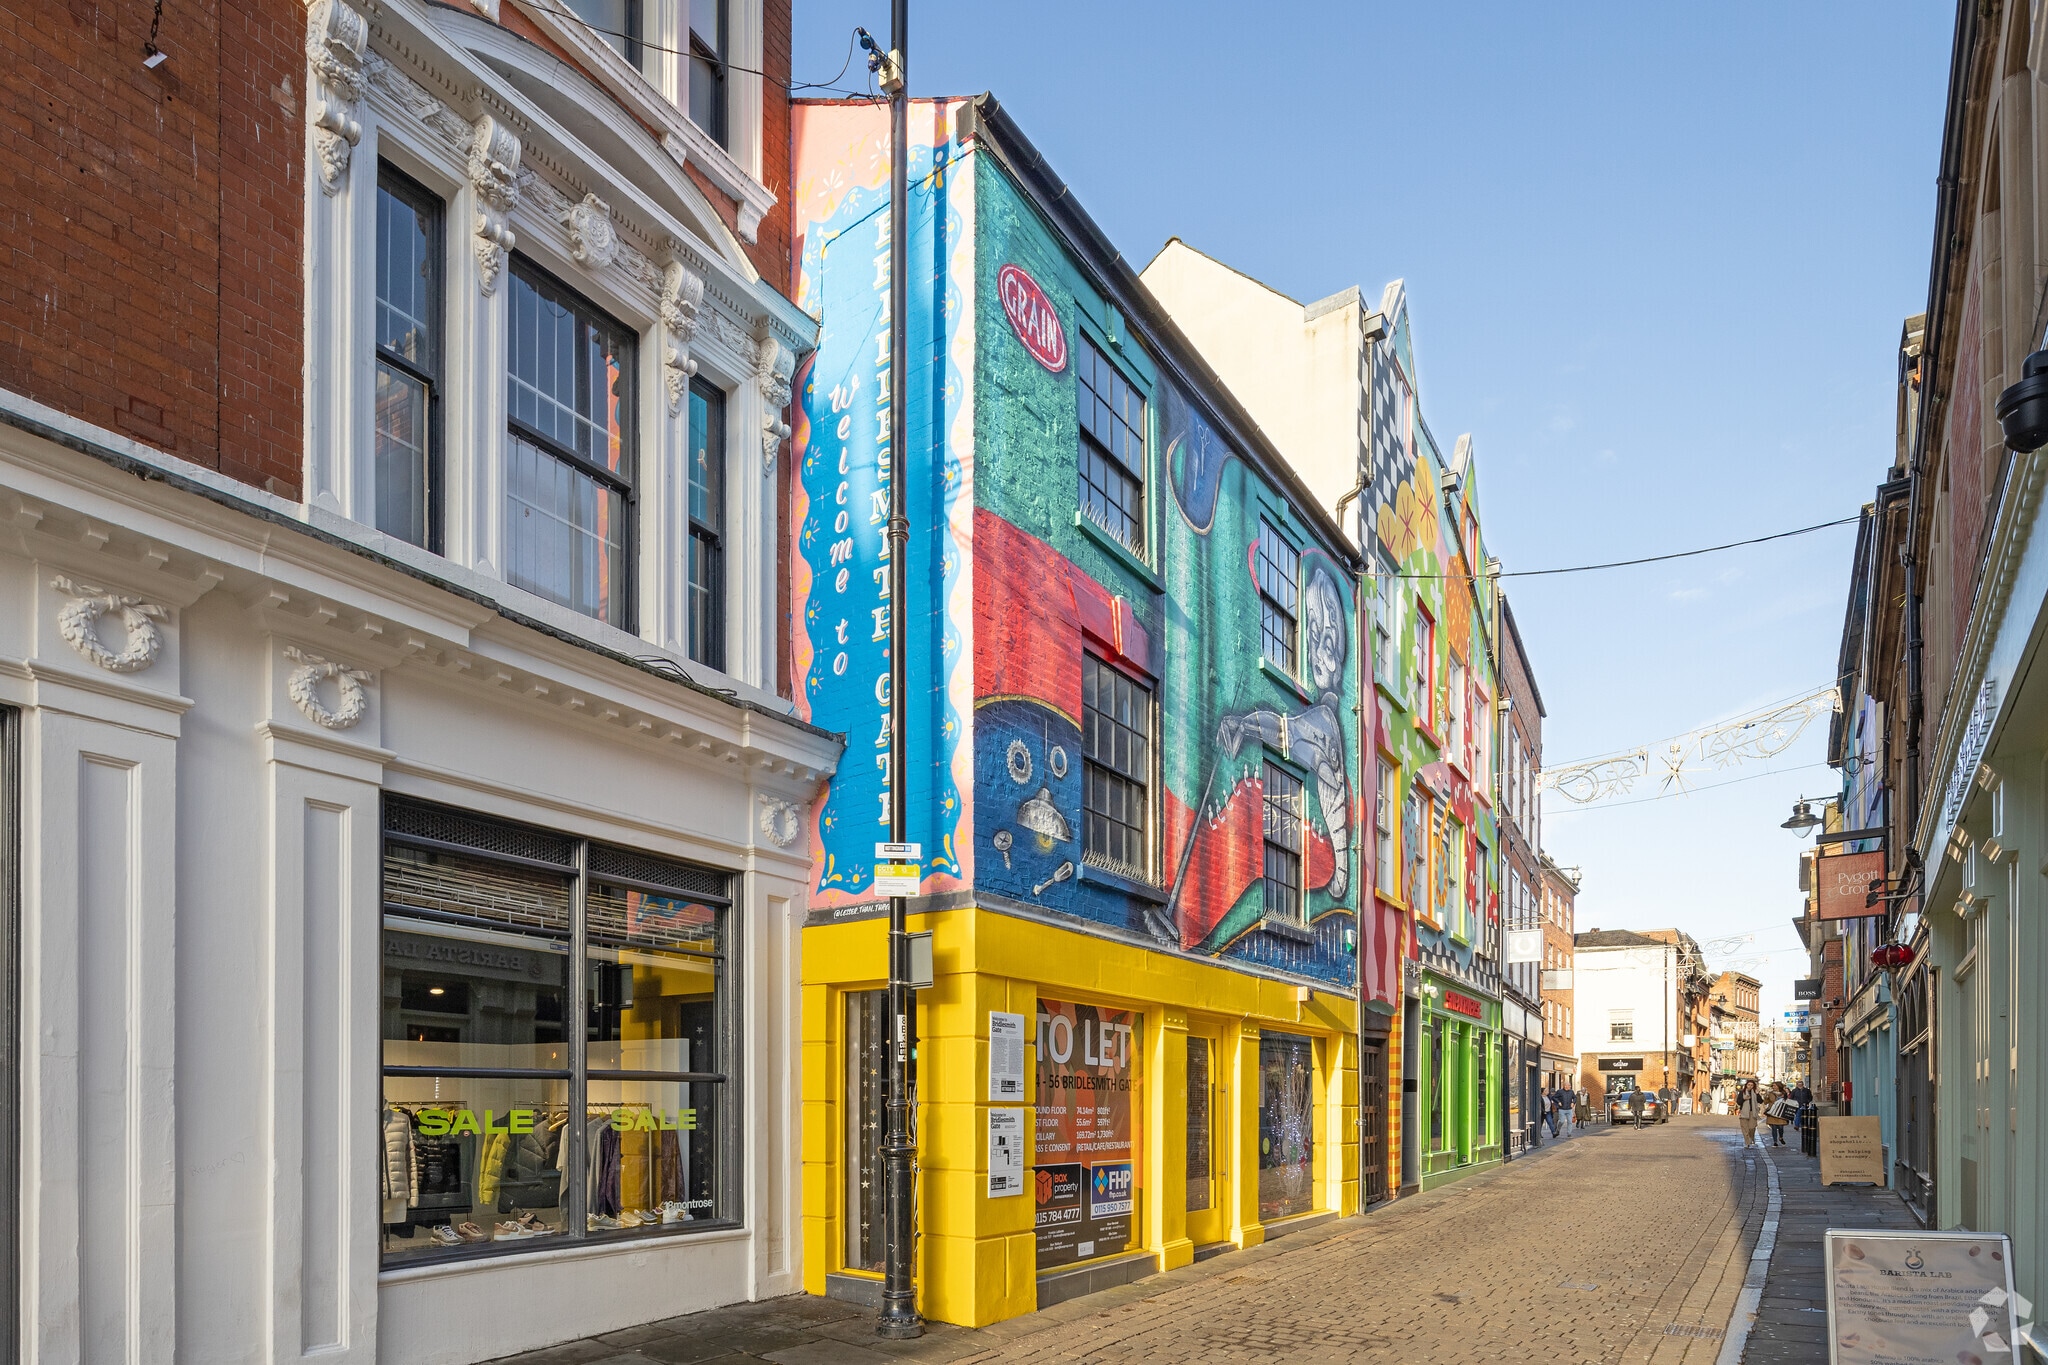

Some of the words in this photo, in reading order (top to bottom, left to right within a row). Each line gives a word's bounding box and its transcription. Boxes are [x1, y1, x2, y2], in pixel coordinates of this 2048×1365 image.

[1004, 273, 1057, 359] GRAIN
[828, 373, 860, 593] Welcome
[833, 618, 850, 676] to
[1838, 870, 1878, 884] Pygott
[1839, 885, 1870, 896] Cron
[1036, 1013, 1073, 1064] TO
[1084, 1019, 1131, 1068] LET
[1049, 1075, 1059, 1088] 56
[1062, 1075, 1116, 1091] BRIDLESMITH
[1036, 1106, 1050, 1114] OUND
[418, 1109, 534, 1136] SALE
[611, 1108, 697, 1132] SALE
[1049, 1143, 1070, 1152] CONSENT
[1054, 1174, 1067, 1183] BOX
[1109, 1170, 1131, 1190] FHP
[1054, 1183, 1078, 1193] property
[1095, 1204, 1106, 1213] 0115
[1107, 1202, 1117, 1211] 950
[1119, 1201, 1130, 1210] 7577
[1048, 1210, 1062, 1222] 784
[1063, 1208, 1079, 1219] 4777
[1880, 1270, 1927, 1278] BARISTA
[1930, 1271, 1952, 1279] LAB
